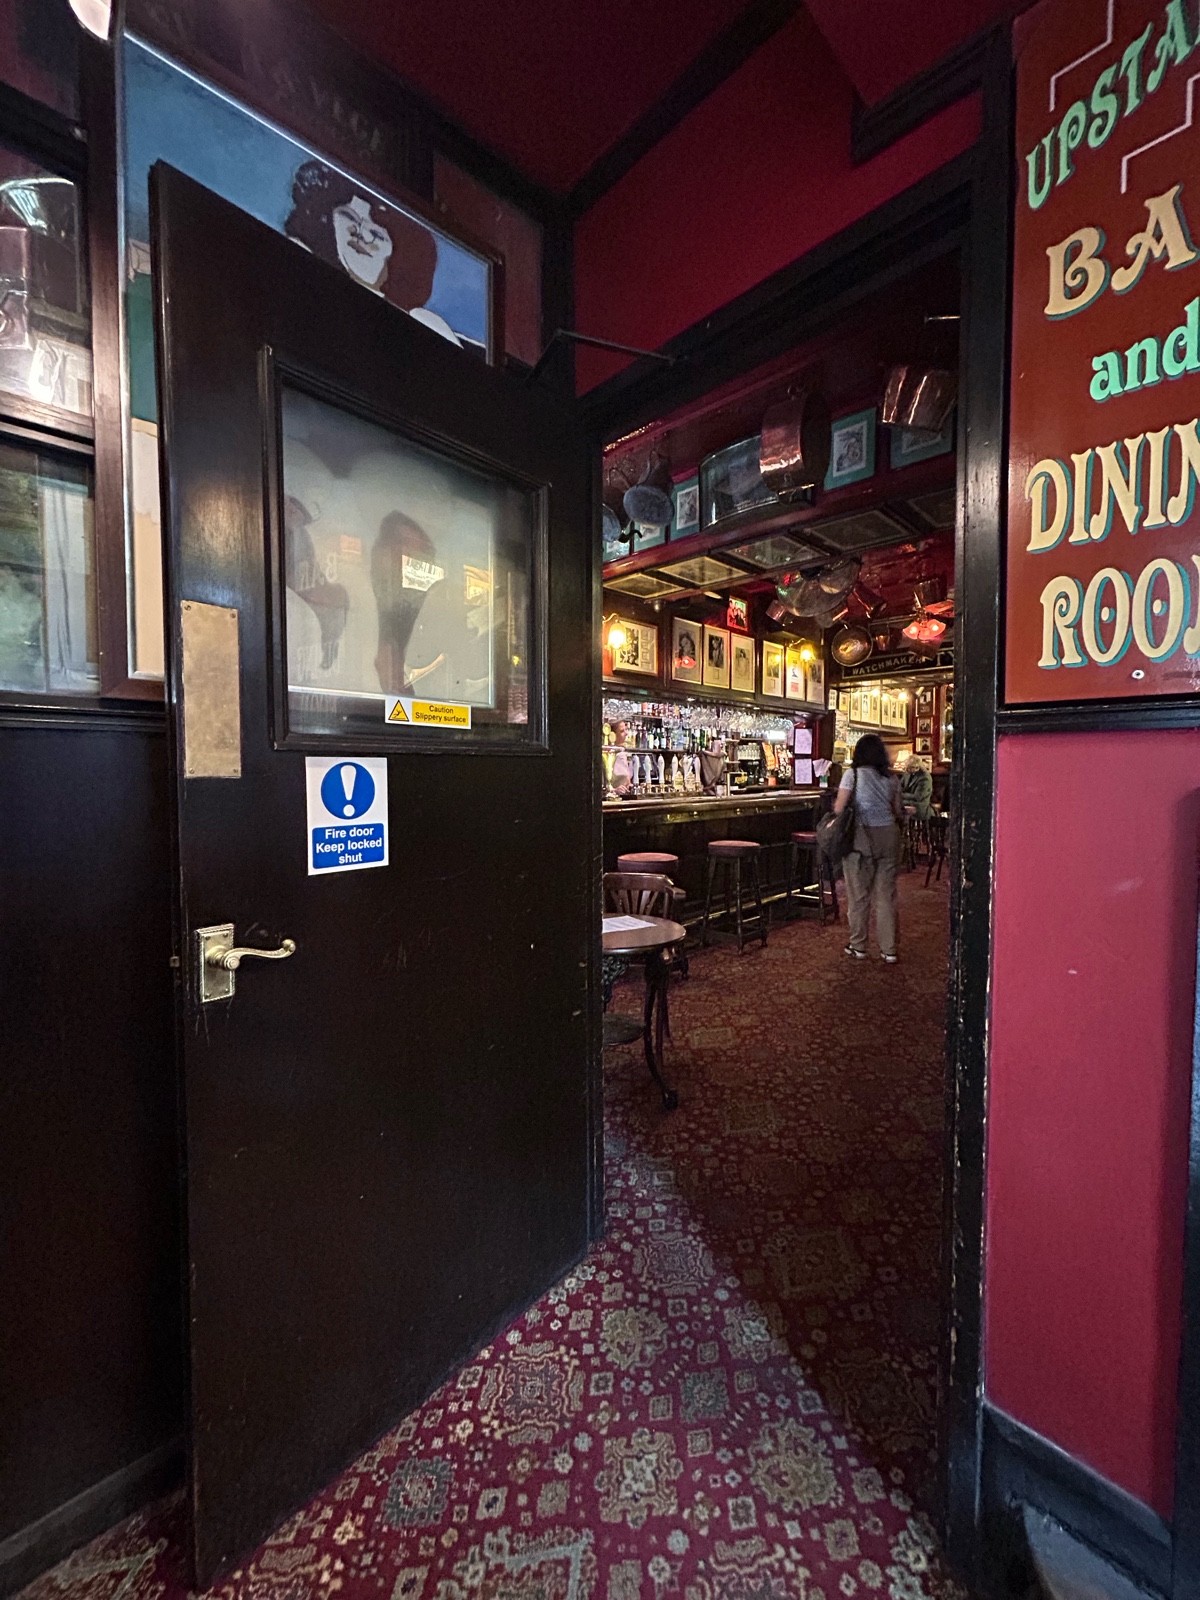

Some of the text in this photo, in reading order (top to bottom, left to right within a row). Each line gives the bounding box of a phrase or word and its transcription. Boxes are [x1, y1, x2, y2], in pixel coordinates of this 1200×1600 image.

[1026, 0, 1200, 209] UPSTA
[1090, 296, 1200, 401] and
[429, 705, 454, 714] Caution
[415, 711, 467, 723] Slippery surface
[325, 827, 374, 839] Fire door
[316, 837, 383, 854] Keep locked
[338, 852, 363, 864] shut
